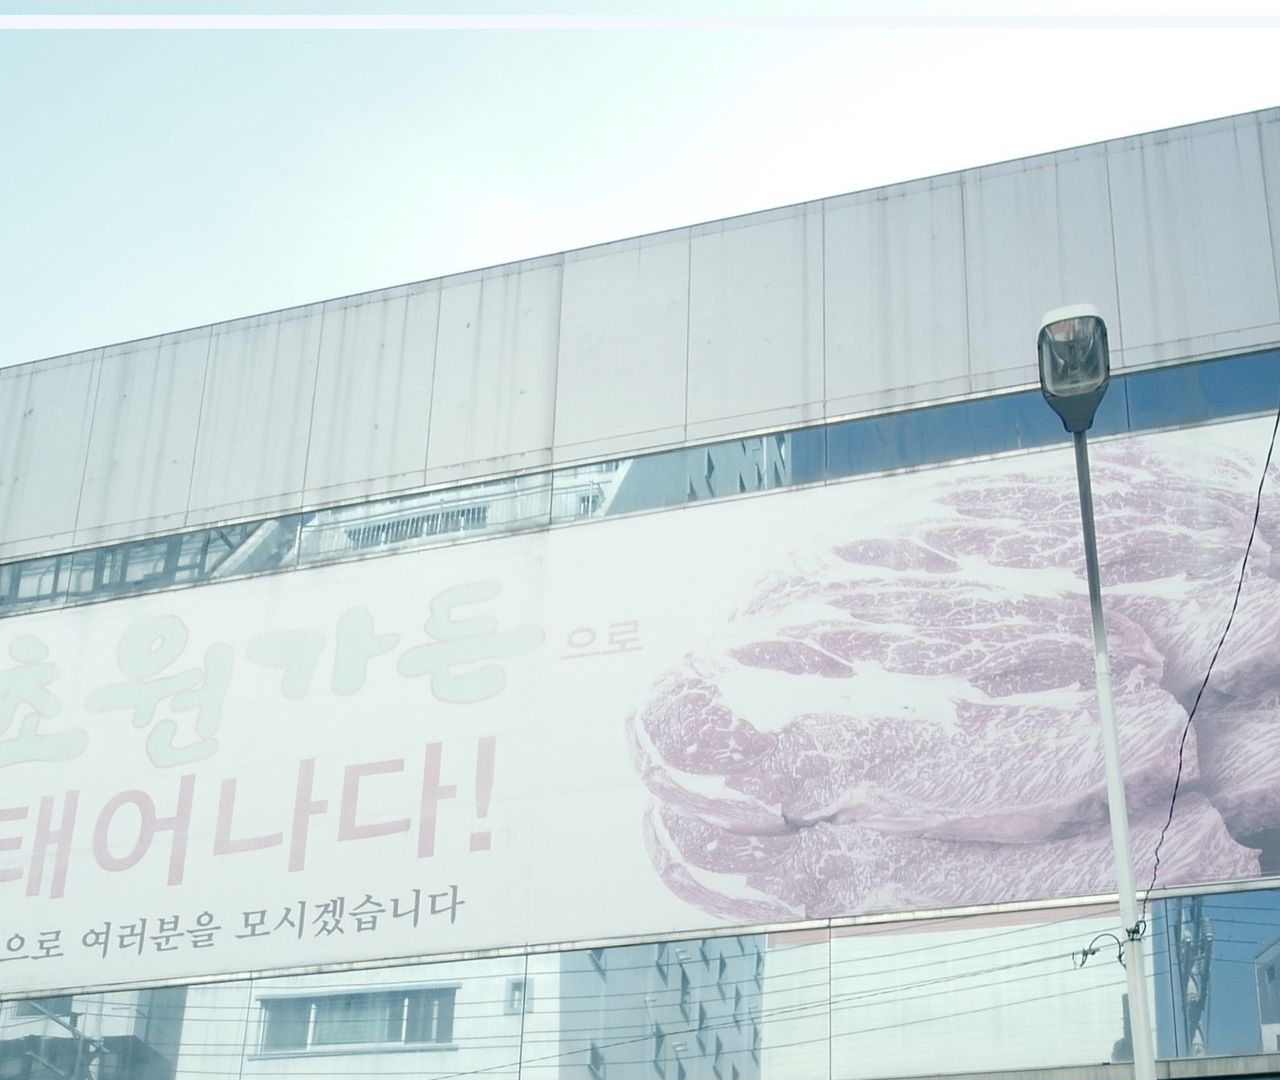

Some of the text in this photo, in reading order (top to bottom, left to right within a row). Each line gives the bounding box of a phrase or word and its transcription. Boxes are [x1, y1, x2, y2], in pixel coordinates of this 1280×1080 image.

[560, 620, 645, 662] 으로
[81, 909, 222, 961] 여러분을
[234, 884, 467, 942] 모시겠습니다
